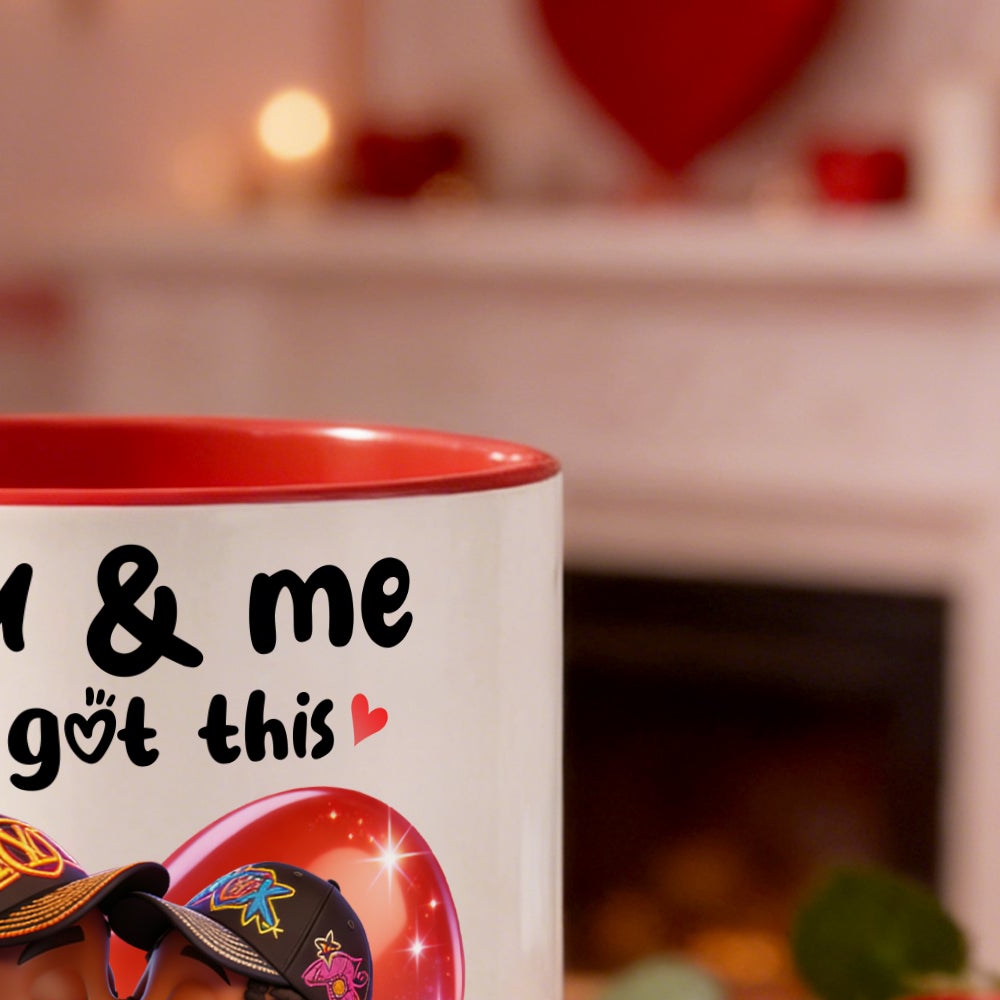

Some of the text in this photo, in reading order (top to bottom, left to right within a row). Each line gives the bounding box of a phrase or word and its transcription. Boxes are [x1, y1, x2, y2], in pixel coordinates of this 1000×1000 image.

[86, 543, 204, 678] &
[248, 556, 414, 655] me
[7, 686, 160, 792] got
[197, 689, 335, 765] this
